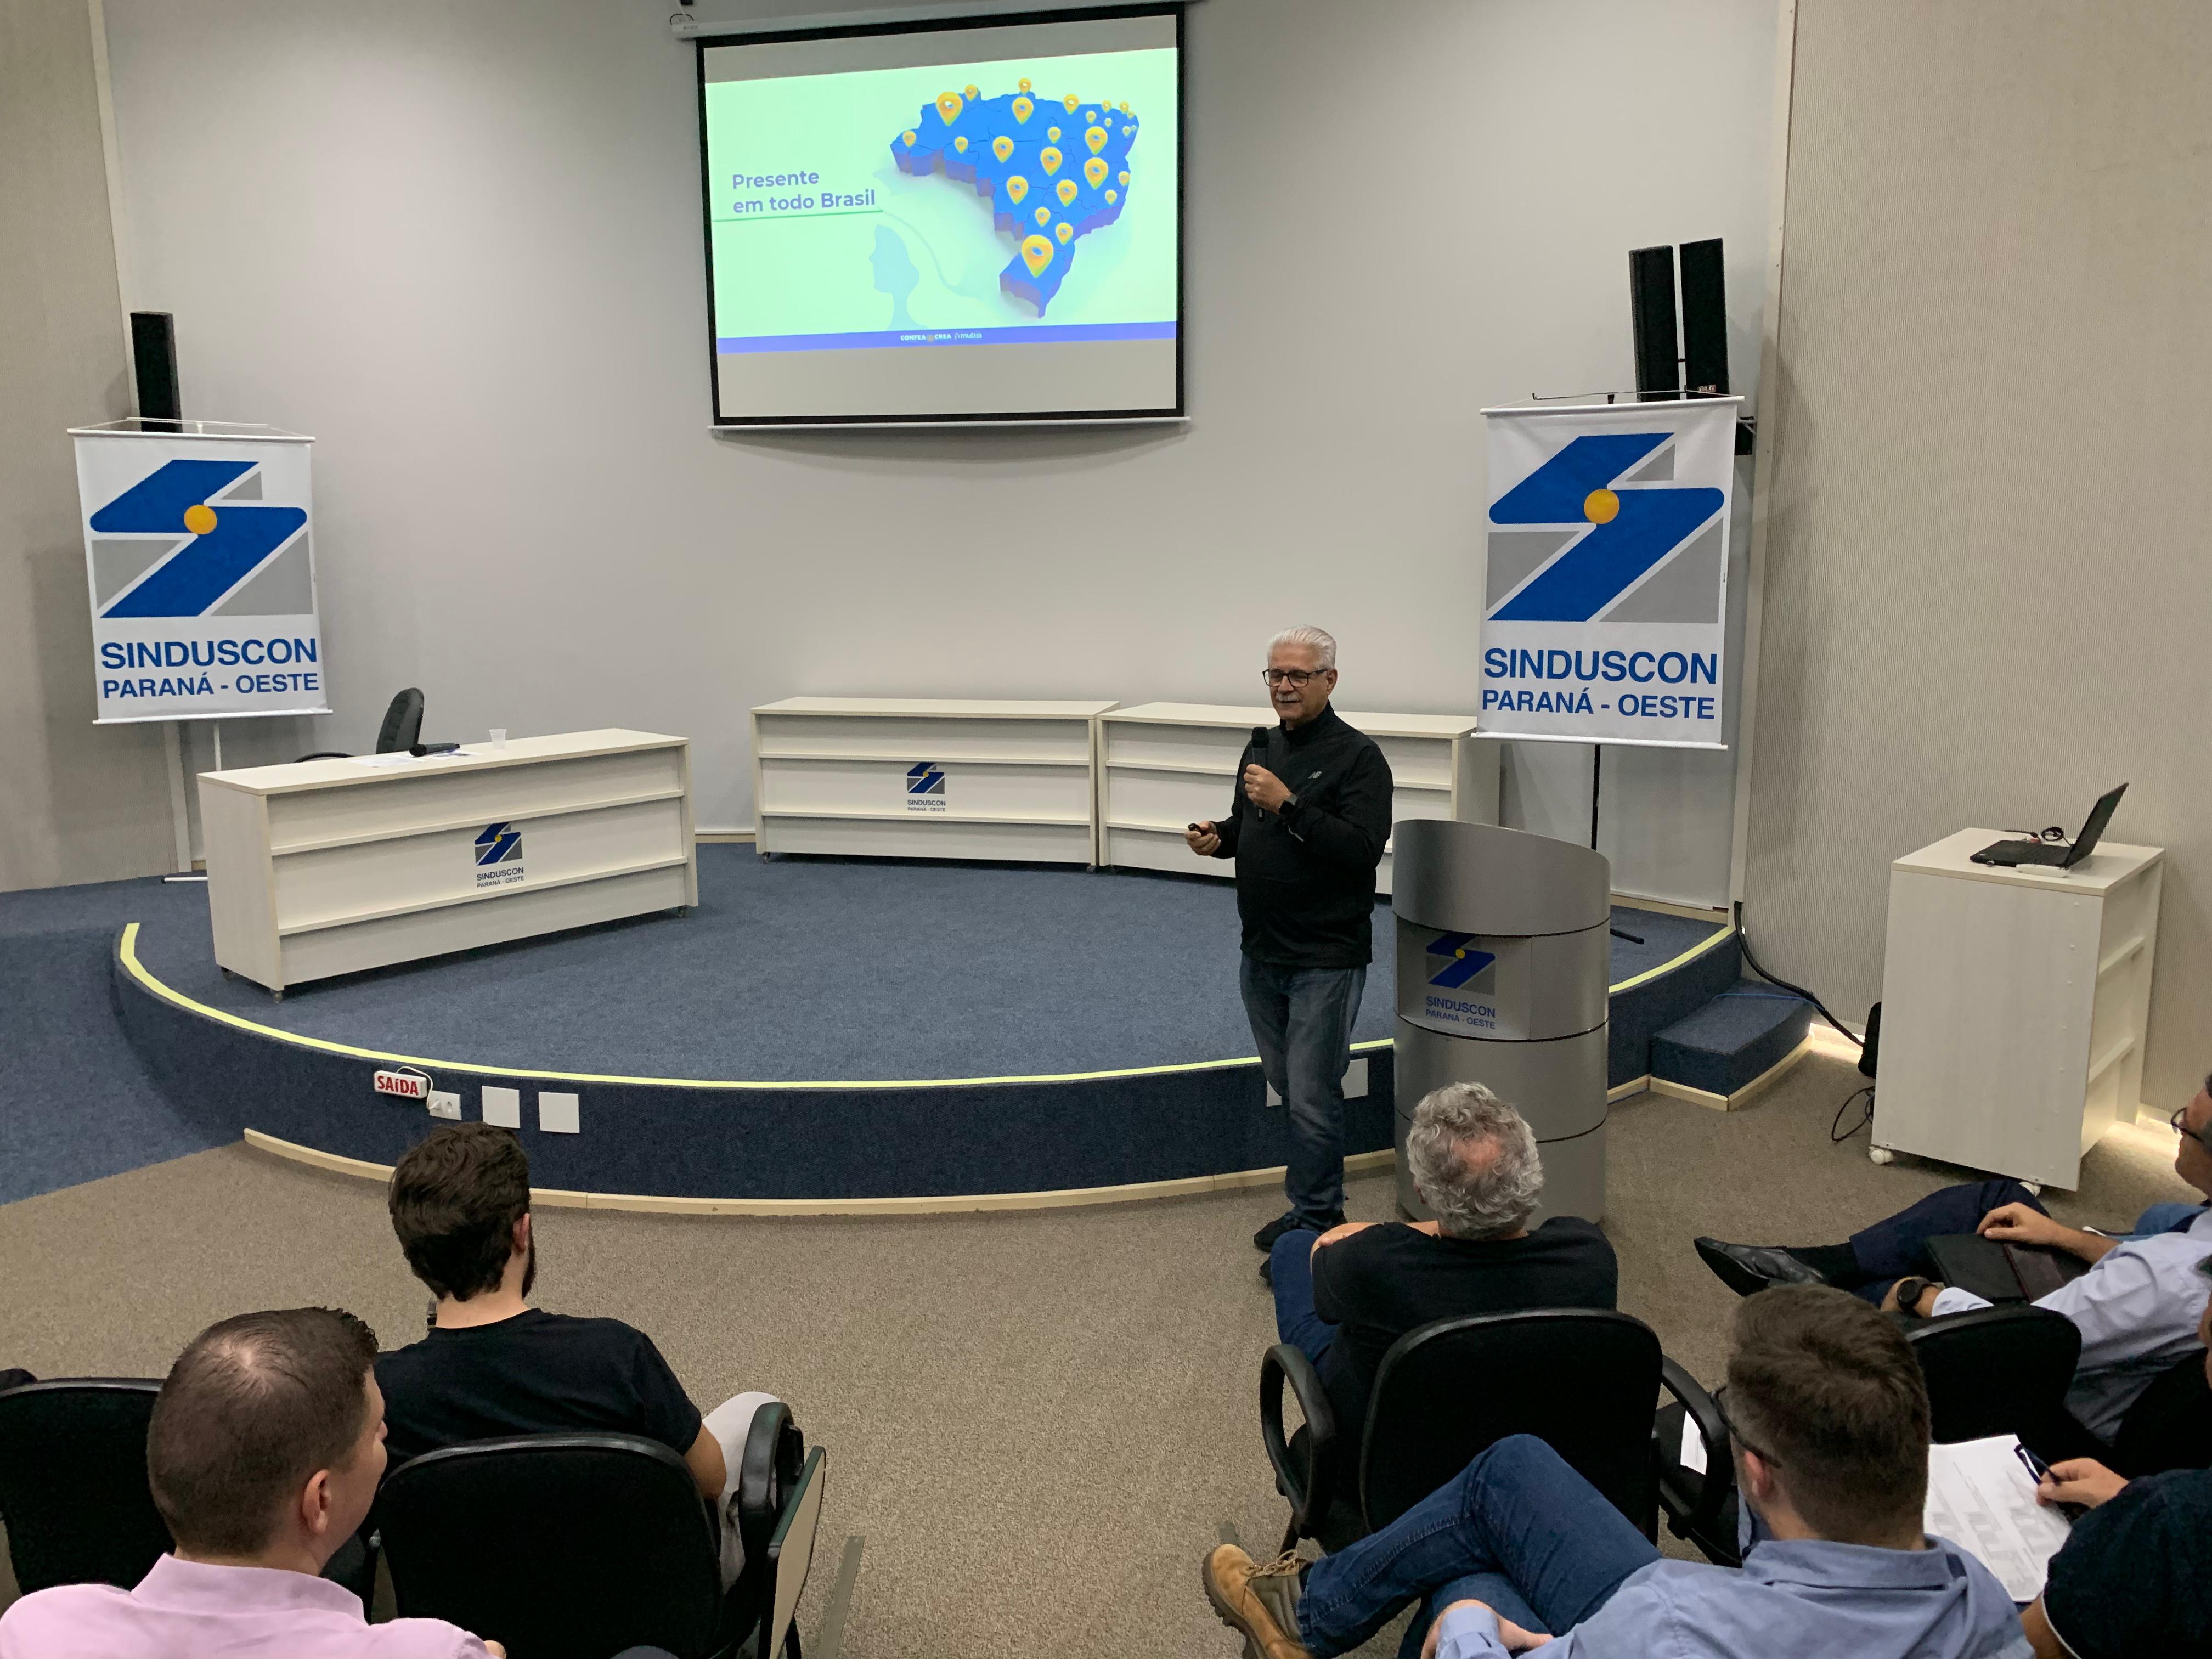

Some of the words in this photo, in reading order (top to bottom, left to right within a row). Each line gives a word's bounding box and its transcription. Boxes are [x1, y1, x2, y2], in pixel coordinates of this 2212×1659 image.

[732, 171, 820, 189] Presente
[733, 200, 764, 213] em
[769, 194, 815, 211] todo
[821, 189, 876, 208] Brasil
[100, 637, 317, 670] SINDUSCON
[1483, 647, 1718, 685] SINDUSCON
[103, 672, 214, 698] PARANÁ
[236, 672, 320, 694] OESTE
[1482, 687, 1594, 715] PARANÁ
[1618, 693, 1715, 720] OESTE
[476, 866, 524, 881] SINDUSCON
[477, 879, 501, 888] PARANÁ
[505, 876, 524, 884] OESTE
[1426, 995, 1496, 1018] SINDUSCON
[1426, 1008, 1460, 1023] PARANÁ
[1466, 1017, 1496, 1029] OESTE
[377, 1075, 419, 1096] SAÍDA
